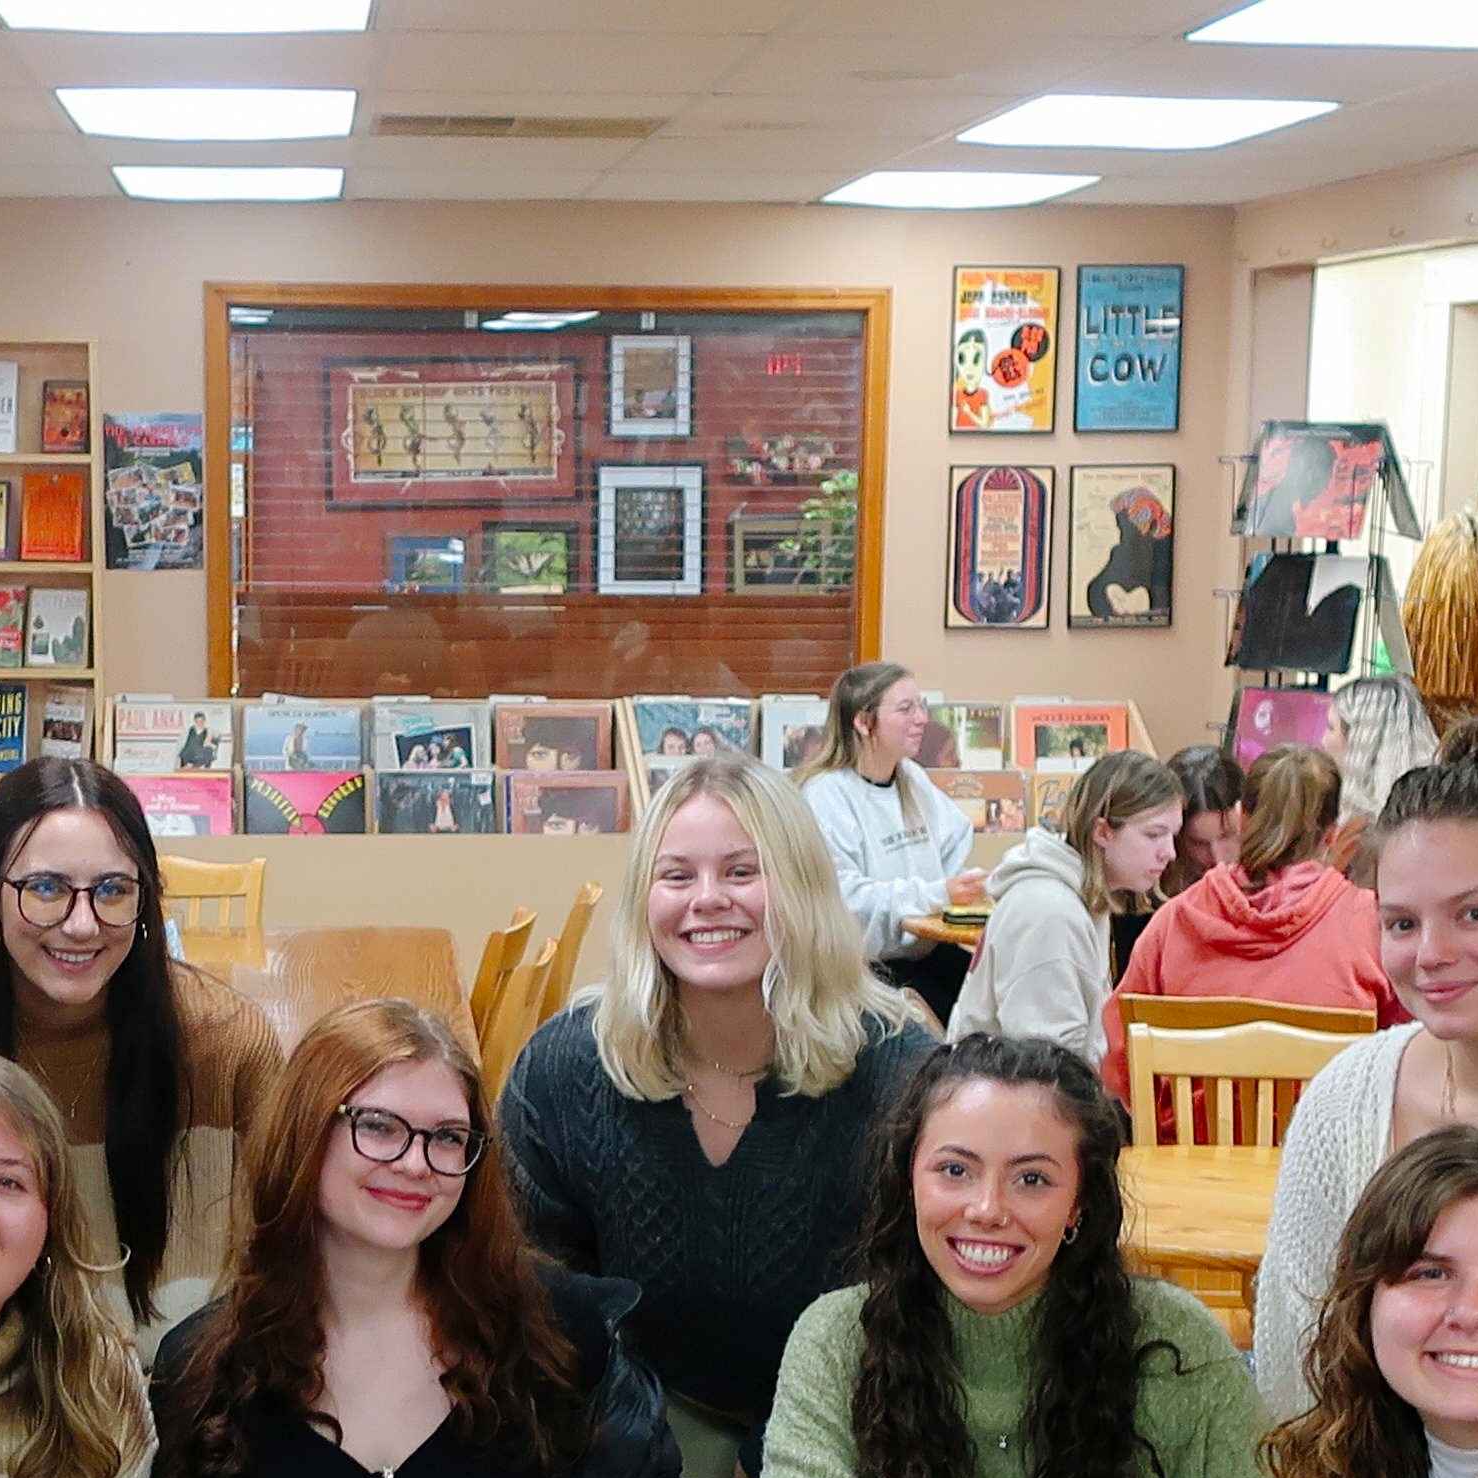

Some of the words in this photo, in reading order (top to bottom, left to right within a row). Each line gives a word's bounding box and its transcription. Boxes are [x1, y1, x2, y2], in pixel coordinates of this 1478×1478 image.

[1082, 305, 1182, 340] LITTLE
[1087, 352, 1168, 387] COW
[118, 709, 147, 731] PAUL
[151, 708, 186, 730] ANKA
